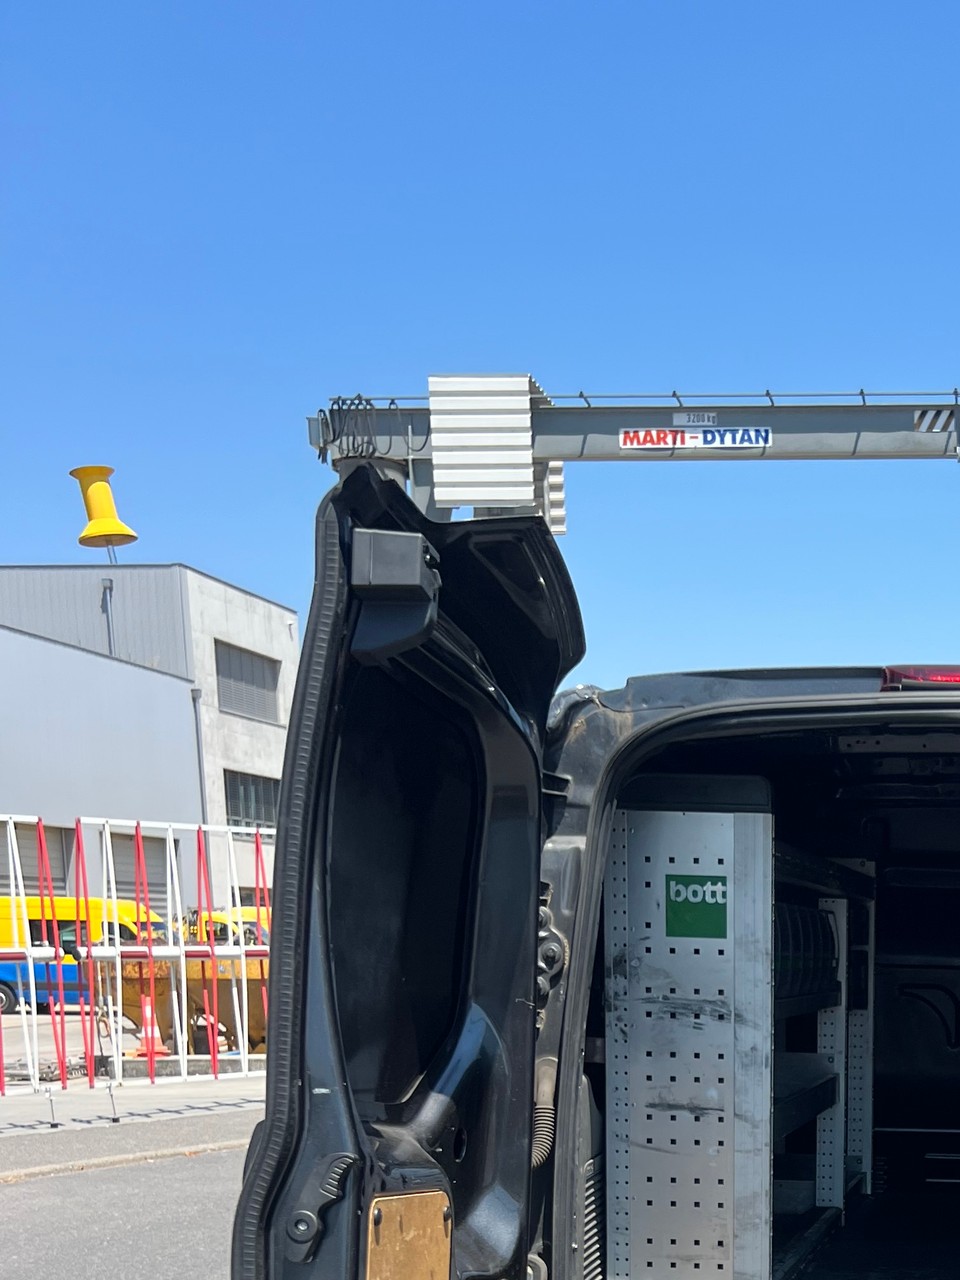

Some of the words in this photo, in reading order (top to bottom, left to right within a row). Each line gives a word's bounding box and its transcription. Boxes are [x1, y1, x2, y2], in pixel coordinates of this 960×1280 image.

[622, 429, 686, 446] MARTI
[702, 429, 770, 445] DYTAN
[669, 880, 727, 904] bott
